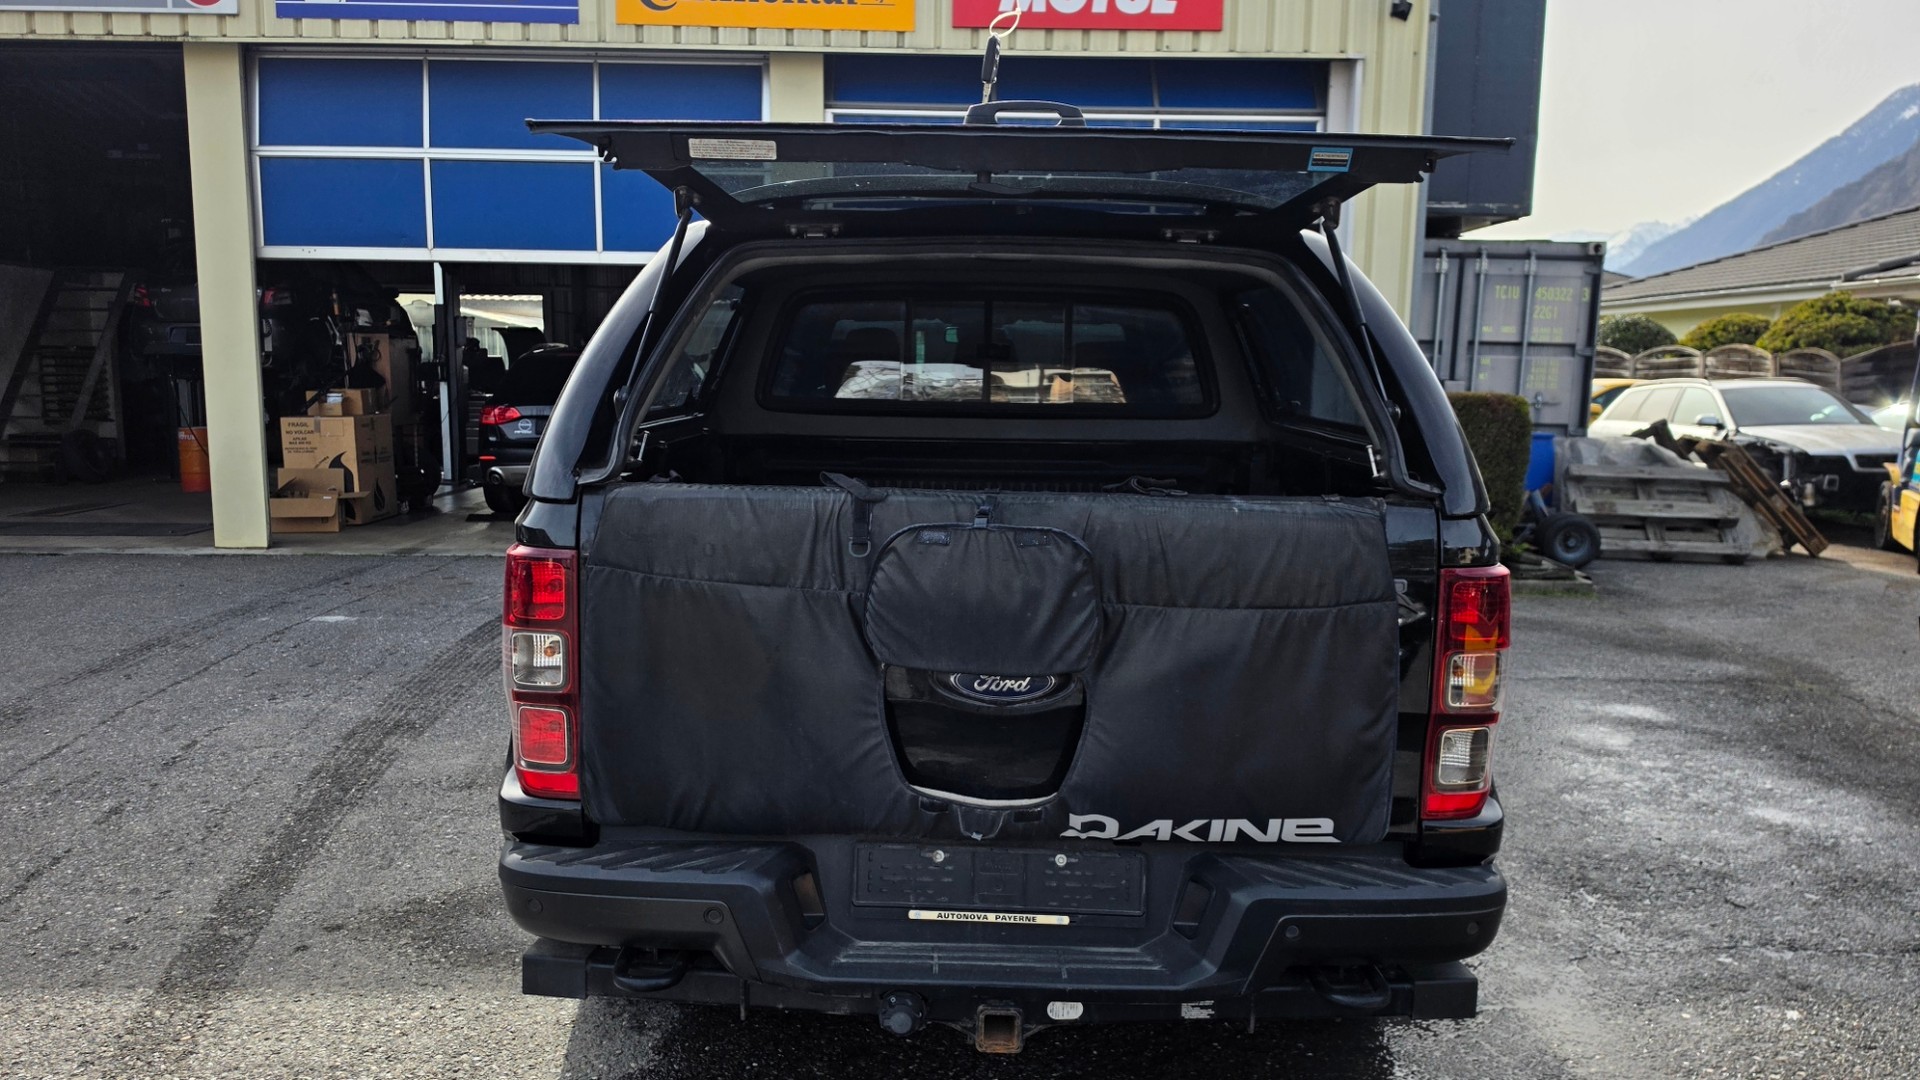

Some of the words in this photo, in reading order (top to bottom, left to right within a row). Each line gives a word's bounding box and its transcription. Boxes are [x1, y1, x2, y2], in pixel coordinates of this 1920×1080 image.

[1495, 285, 1520, 299] TCIU
[1535, 287, 1573, 301] 450322
[1582, 288, 1590, 301] 3
[974, 674, 1031, 692] Ford
[1060, 813, 1341, 843] DAKINE
[936, 912, 988, 921] AUTONOVA
[995, 914, 1037, 923] PAYERNE
